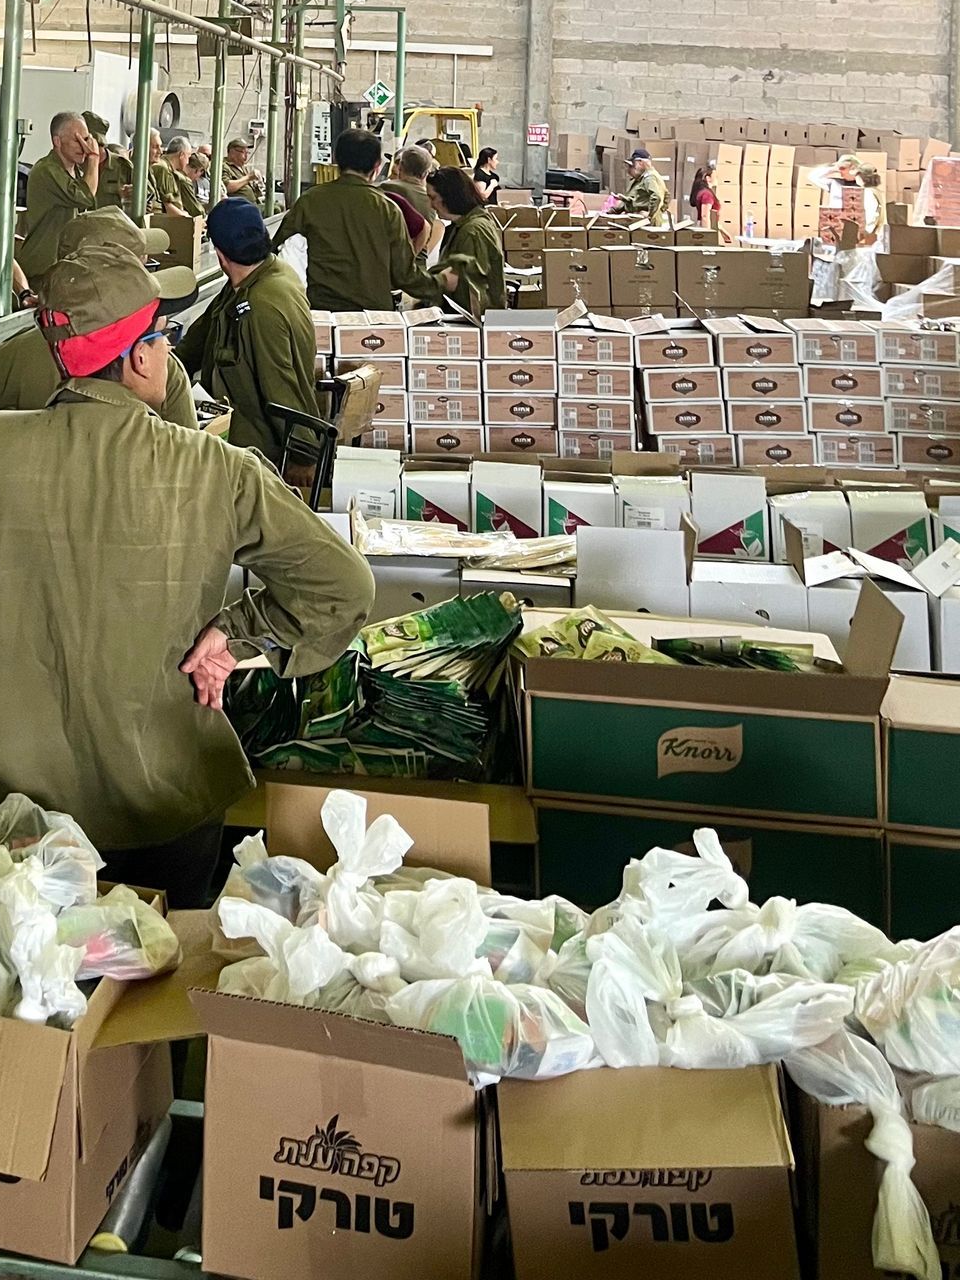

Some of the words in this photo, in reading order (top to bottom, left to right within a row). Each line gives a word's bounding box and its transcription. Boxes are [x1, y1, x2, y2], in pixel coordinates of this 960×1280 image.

[661, 737, 736, 762] Knorr
[273, 1135, 334, 1172] עלית
[339, 1150, 401, 1187] קפה
[259, 1175, 415, 1239] טורקי
[568, 1201, 734, 1253] טורקי
